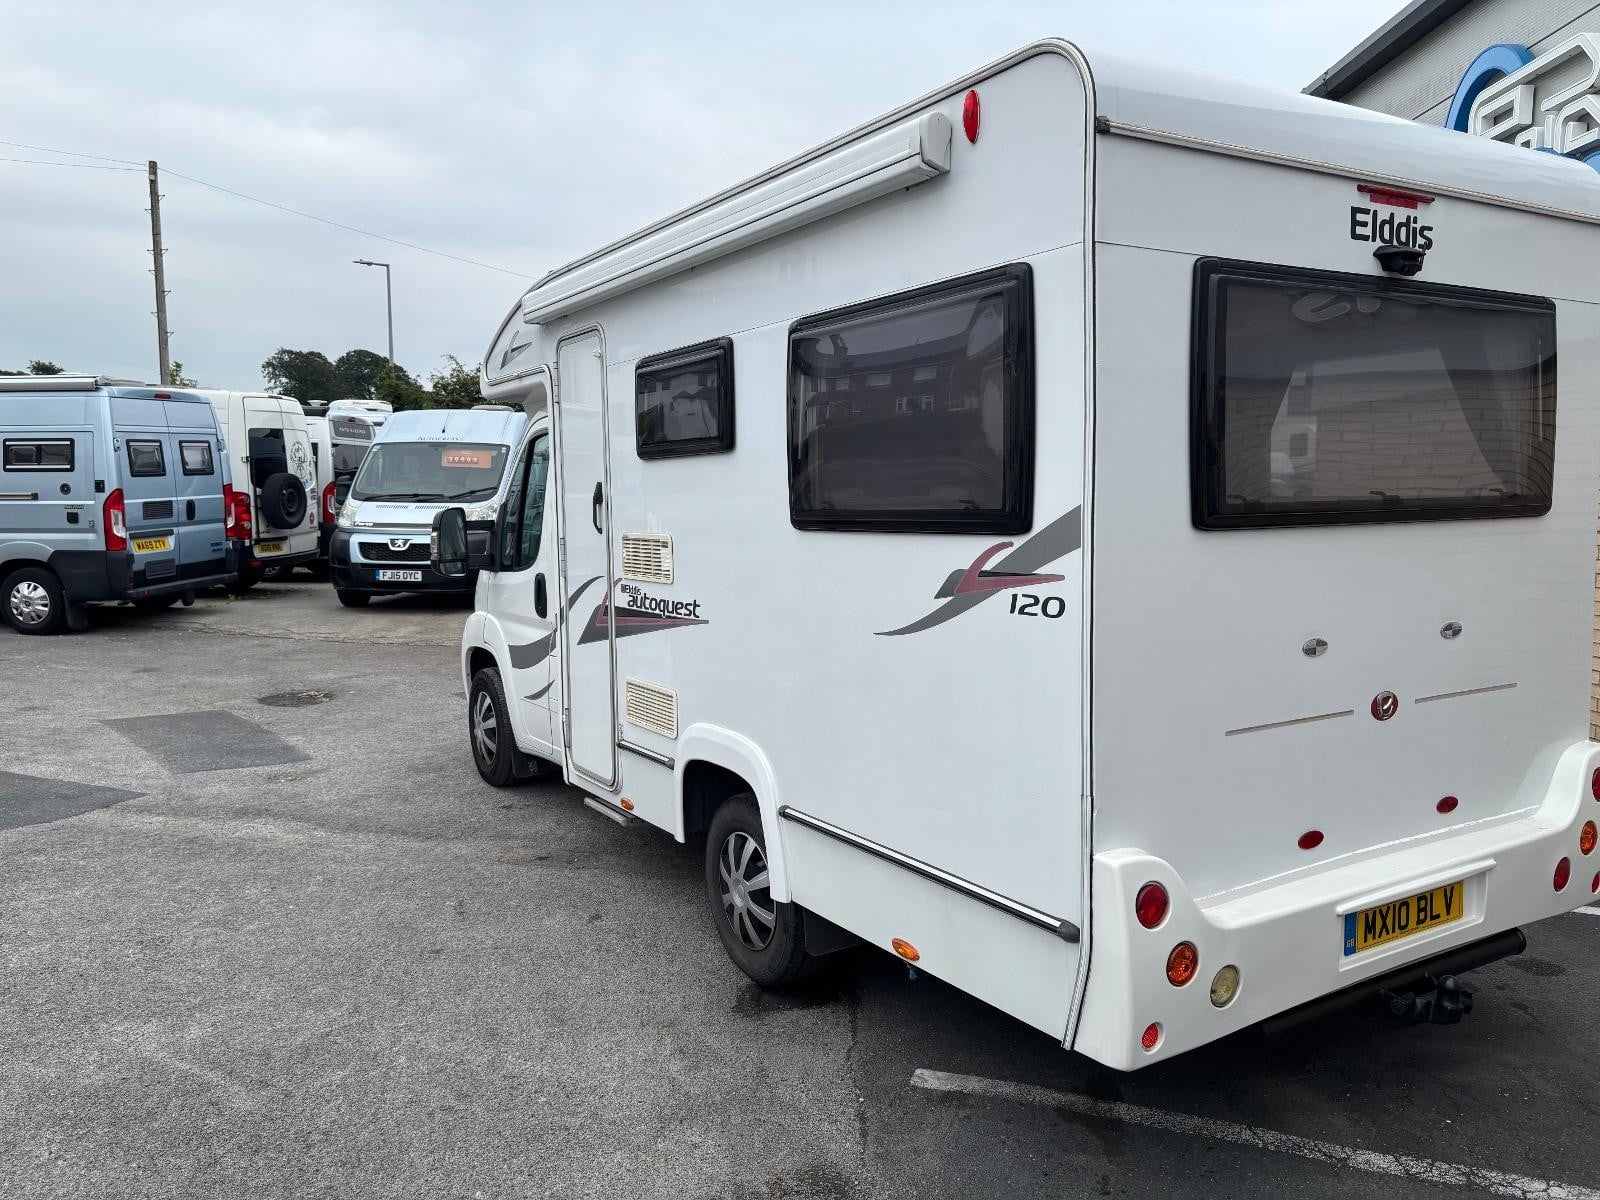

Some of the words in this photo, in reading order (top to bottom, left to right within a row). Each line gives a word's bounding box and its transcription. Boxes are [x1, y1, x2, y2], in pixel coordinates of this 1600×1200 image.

[1350, 206, 1434, 251] Elddis
[382, 571, 401, 580] FJ15
[627, 592, 701, 619] autoquest
[1010, 593, 1066, 619] 120
[1363, 900, 1410, 944] MX10
